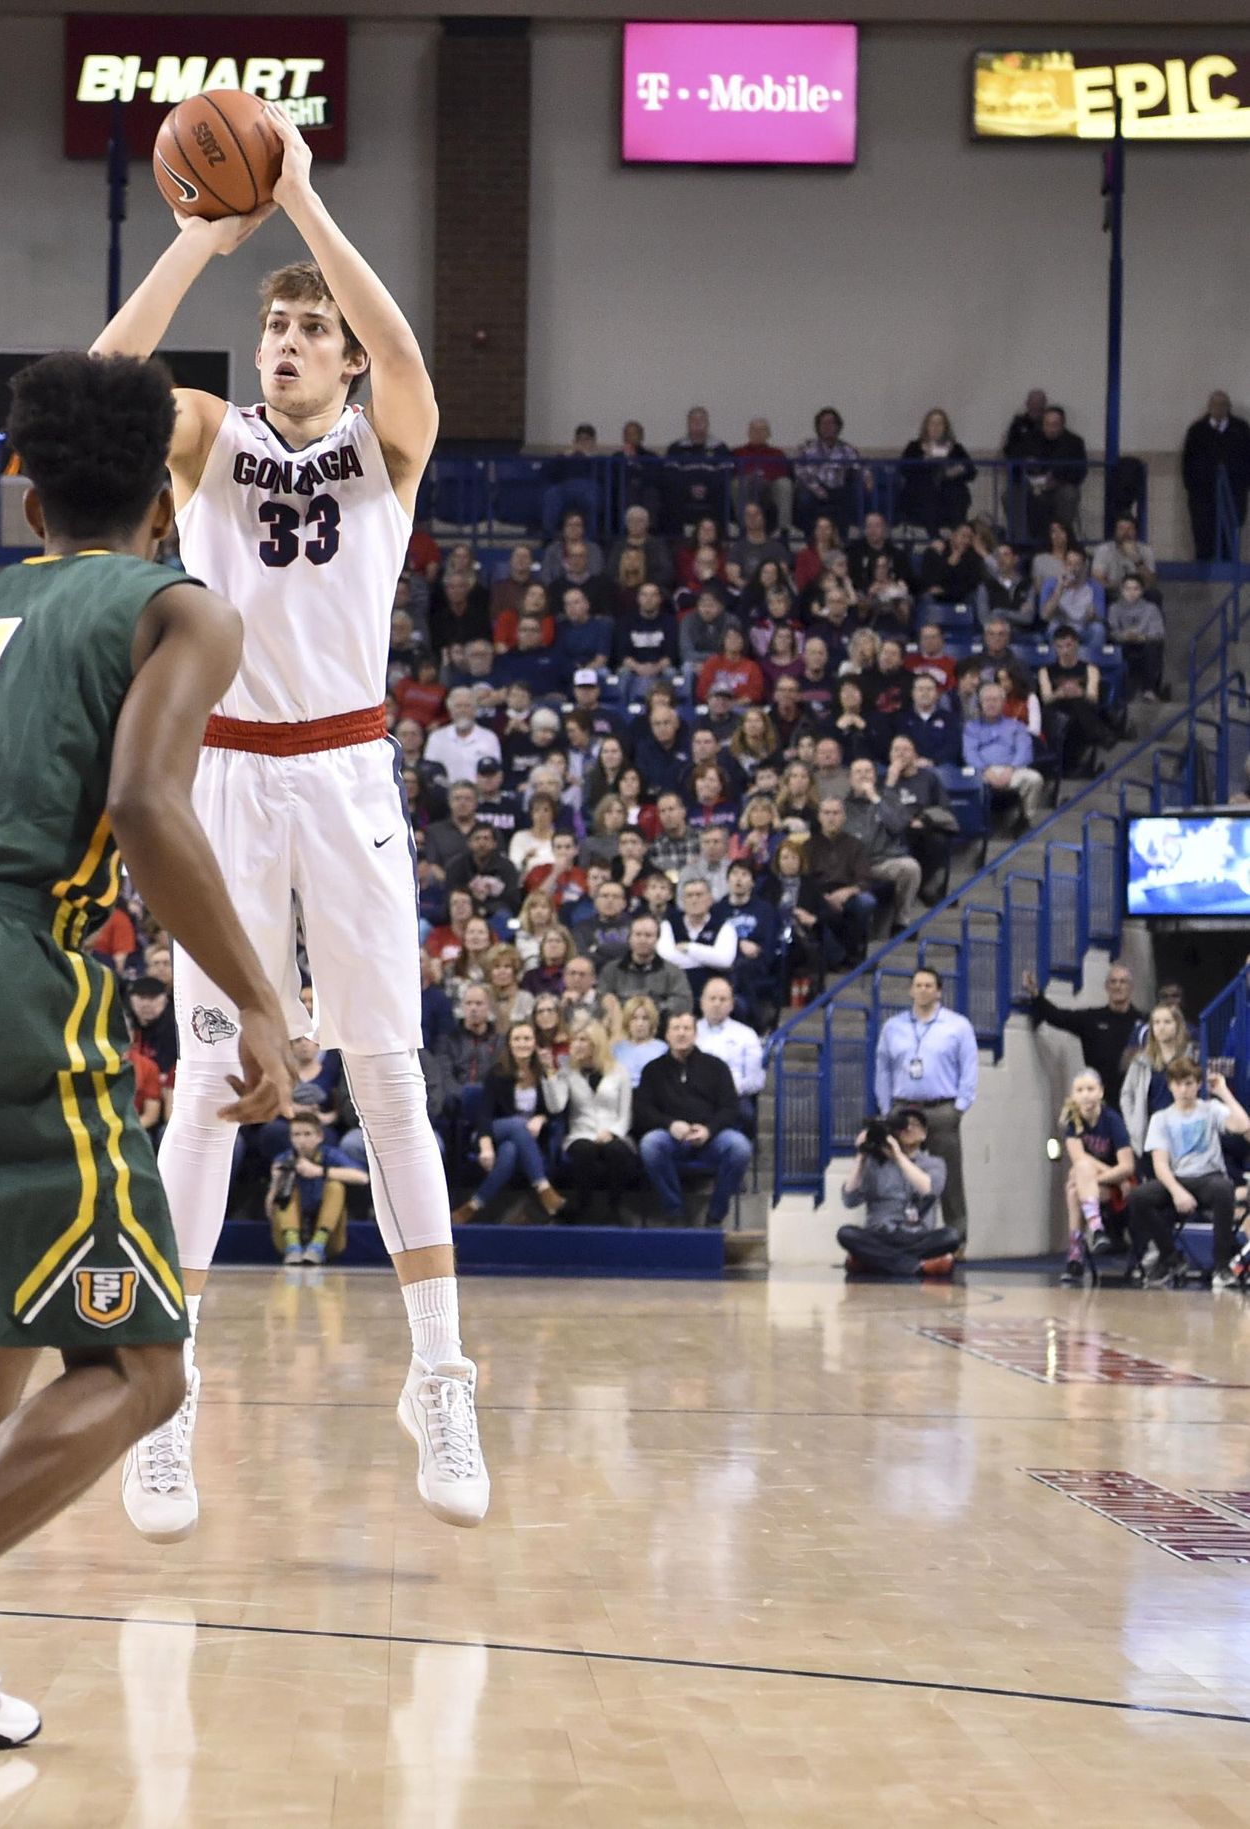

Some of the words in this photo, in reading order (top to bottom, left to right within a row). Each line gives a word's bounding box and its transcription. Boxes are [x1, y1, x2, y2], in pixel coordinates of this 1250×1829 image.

[1073, 54, 1241, 122] EPIC
[232, 444, 364, 496] GONZAGA
[258, 493, 341, 568] 33
